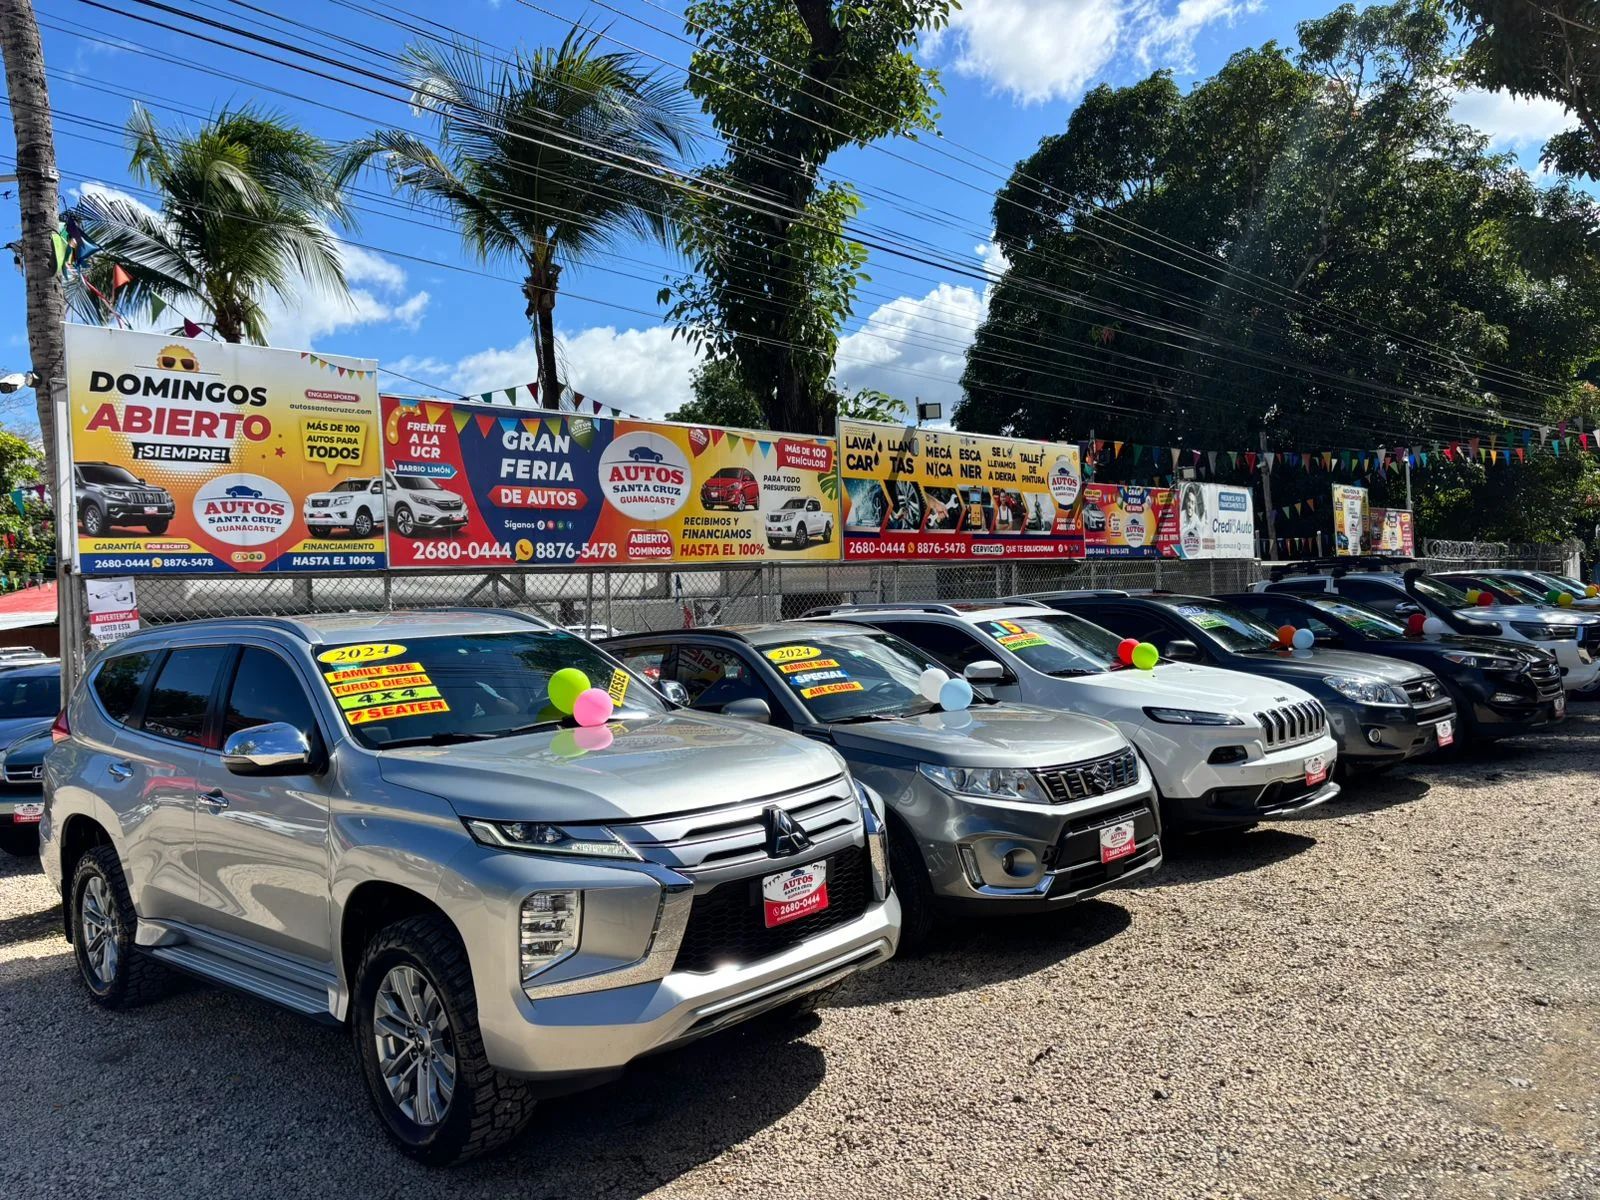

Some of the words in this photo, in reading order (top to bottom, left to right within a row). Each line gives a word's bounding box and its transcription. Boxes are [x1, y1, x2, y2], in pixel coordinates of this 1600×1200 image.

[89, 371, 267, 407] DOMINGOS
[307, 391, 332, 399] ENGLISH
[333, 393, 356, 401] SPOKEN
[289, 403, 372, 415] autossantacruzcr.com
[86, 403, 271, 441] ABIERTO
[307, 420, 329, 431] MÁS
[330, 424, 343, 432] DE
[345, 425, 360, 433] 100
[407, 421, 447, 433] FRENTE
[307, 435, 335, 443] AUTOS
[336, 437, 358, 445] PARA
[409, 433, 419, 444] A
[423, 433, 440, 445] LA
[502, 432, 571, 454] GRAN
[846, 435, 874, 451] LAVA
[307, 445, 360, 460] TODOS
[410, 446, 441, 459] UCR
[802, 447, 810, 455] DE
[812, 448, 827, 458] 100
[888, 440, 911, 453] LLAN
[926, 445, 952, 459] MECÁ
[137, 445, 227, 461] ¡SIEMPRE!
[959, 448, 981, 461] ESCA
[786, 455, 826, 468] VEHÍCULOS!
[846, 453, 874, 472] CAR
[890, 456, 914, 474] TAS
[988, 460, 1016, 469] LLEVAMOS
[398, 463, 426, 473] BARRIO
[427, 464, 451, 474] LIMÓN
[500, 458, 574, 482] FERIA
[960, 463, 982, 479] NER
[1029, 465, 1037, 474] DE
[609, 465, 684, 485] AUTOS
[763, 474, 780, 483] PARA
[783, 475, 801, 484] TODO
[988, 471, 994, 480] A
[995, 471, 1017, 482] DEKRA
[1022, 474, 1046, 485] PINTURA
[763, 484, 801, 492] PRESUPUESTO
[1052, 477, 1078, 487] AUTOS
[612, 483, 647, 494] SANTA
[648, 484, 681, 496] CRUZ
[500, 488, 522, 504] DE
[526, 489, 577, 506] AUTOS
[620, 495, 676, 506] GUANACASTE
[204, 501, 285, 516] AUTOS
[208, 516, 248, 524] SANTA
[251, 516, 282, 525] CRUZ
[504, 520, 535, 530] Síganos
[683, 517, 731, 526] RECIBIMOS
[733, 517, 739, 525] Y
[216, 525, 276, 533] GUANACASTE
[682, 528, 752, 539] FINANCIAMOS
[1126, 526, 1145, 534] AUTOS
[630, 533, 669, 544] ABIERTO
[94, 541, 141, 550] GARANTÍA
[412, 541, 512, 560] 2680-0444
[535, 542, 617, 559] 8876-5478
[628, 545, 671, 555] DOMINGOS
[680, 543, 720, 556] HASTA
[722, 543, 735, 555] EL
[739, 543, 765, 555] 100%
[849, 541, 906, 554] 2680-0444
[917, 542, 966, 554] 8876-5478
[972, 544, 1003, 553] SERVICIOS
[1006, 545, 1017, 554] QUE
[1023, 545, 1055, 553] SOLUCIONAN
[95, 559, 150, 568] 2680-0444
[163, 558, 214, 567] 8876-5478
[292, 556, 330, 566] HASTA
[333, 556, 346, 565] EL
[349, 556, 376, 565] 100%
[335, 645, 390, 661] 2024
[779, 647, 811, 659] 2024
[333, 666, 380, 680] FAMILY
[384, 663, 416, 675] SIZE
[784, 663, 813, 672] FAMILY
[796, 670, 847, 683] SPECIAL
[333, 680, 379, 694] TURBO
[382, 675, 426, 688] DIESEL
[609, 671, 627, 701] DIESEL
[809, 687, 826, 696] AIR
[349, 711, 364, 723] 7
[370, 701, 445, 718] SEATER
[783, 874, 814, 891] AUTOS
[784, 885, 800, 896] SANTA
[780, 893, 820, 915] 2680-0444
